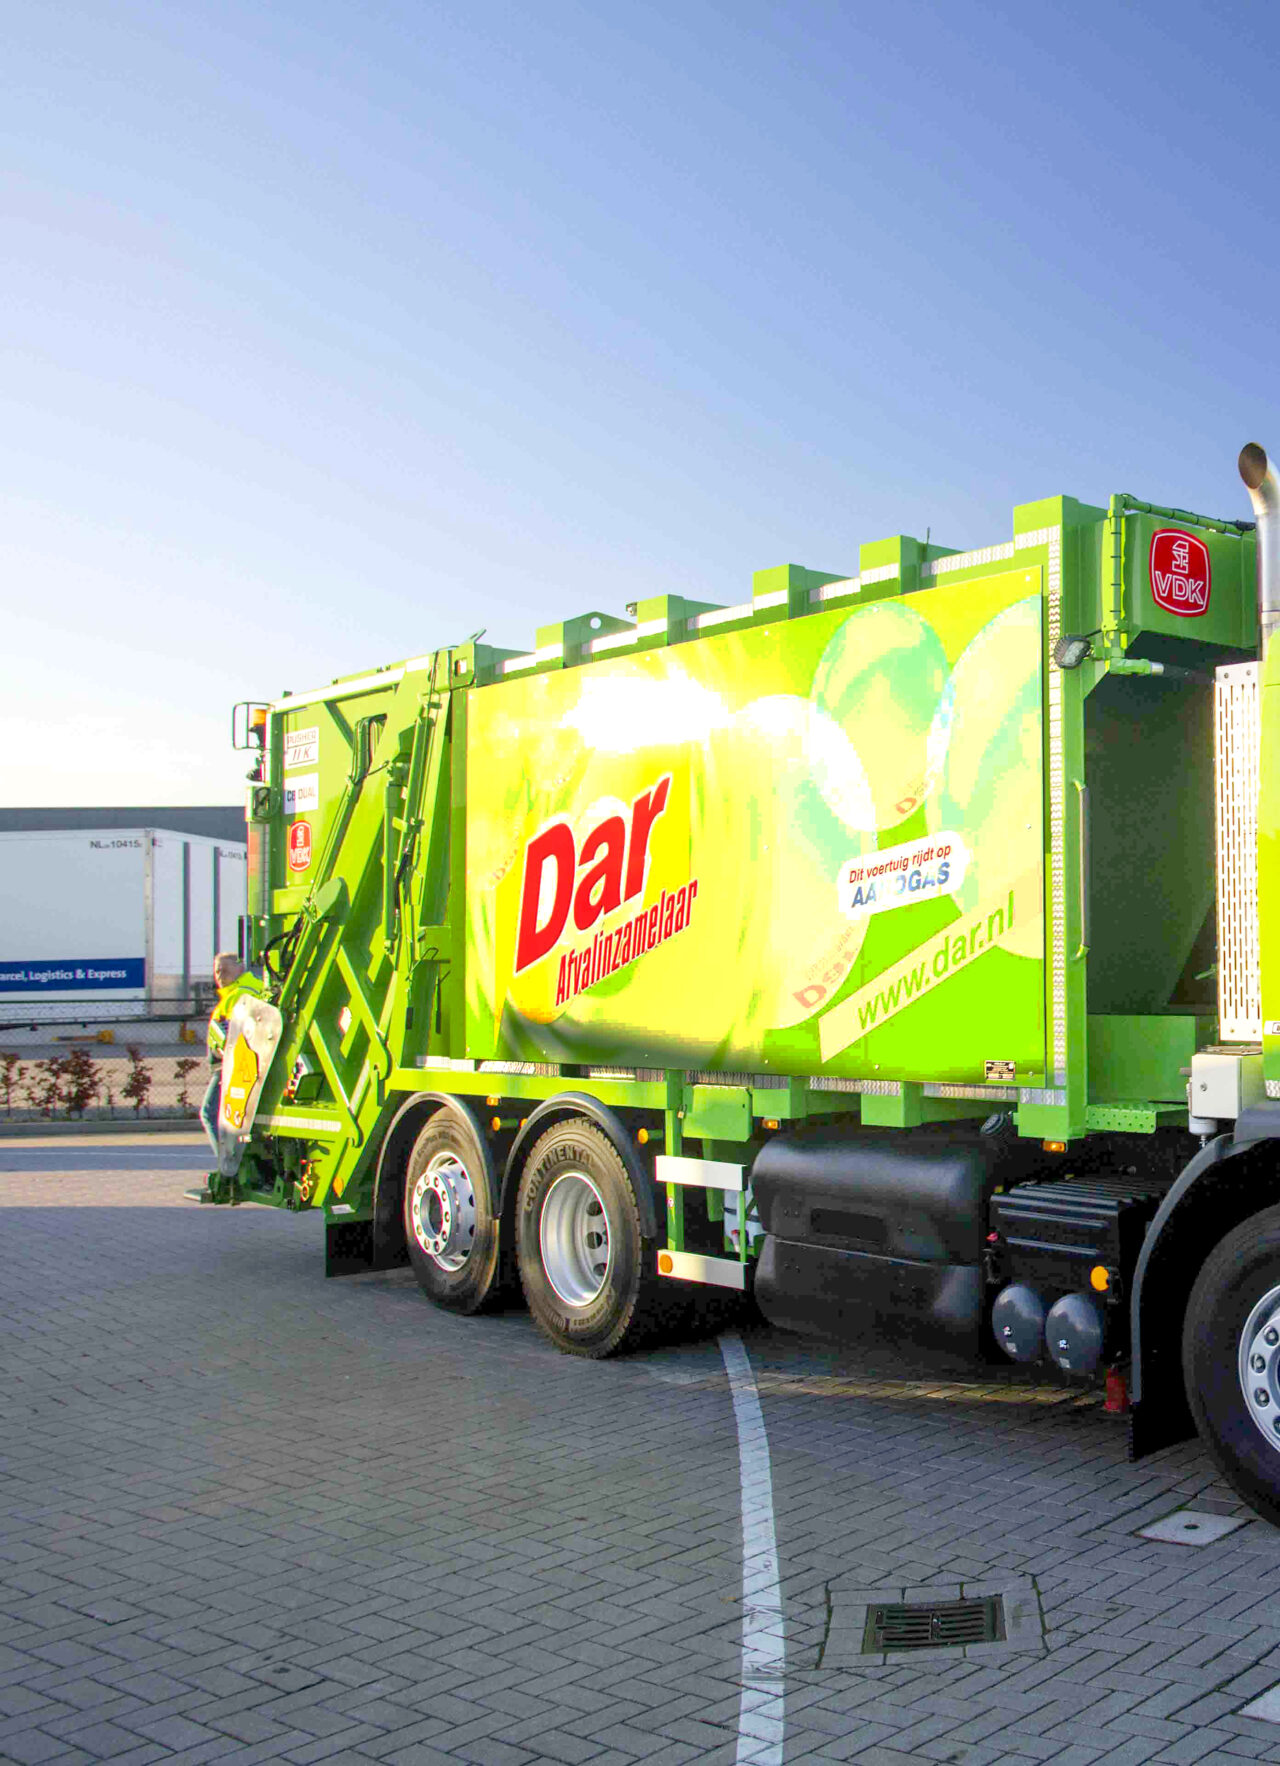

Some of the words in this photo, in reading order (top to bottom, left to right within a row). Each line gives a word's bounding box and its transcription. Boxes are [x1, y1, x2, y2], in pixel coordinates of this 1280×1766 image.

[1155, 570, 1204, 605] VDK
[515, 777, 670, 973] Dar
[849, 868, 864, 883] Dit
[867, 856, 909, 878] voertuig
[912, 847, 934, 867] rijdt
[937, 845, 951, 859] op
[851, 862, 950, 908] AADGAS
[556, 879, 698, 1006] Afvalinzamelaar
[858, 889, 1014, 1029] www.dar.nl
[29, 970, 74, 982] Logistics
[75, 969, 85, 979] &
[87, 969, 127, 981] Express
[524, 1144, 595, 1213] CONTINENTAL
